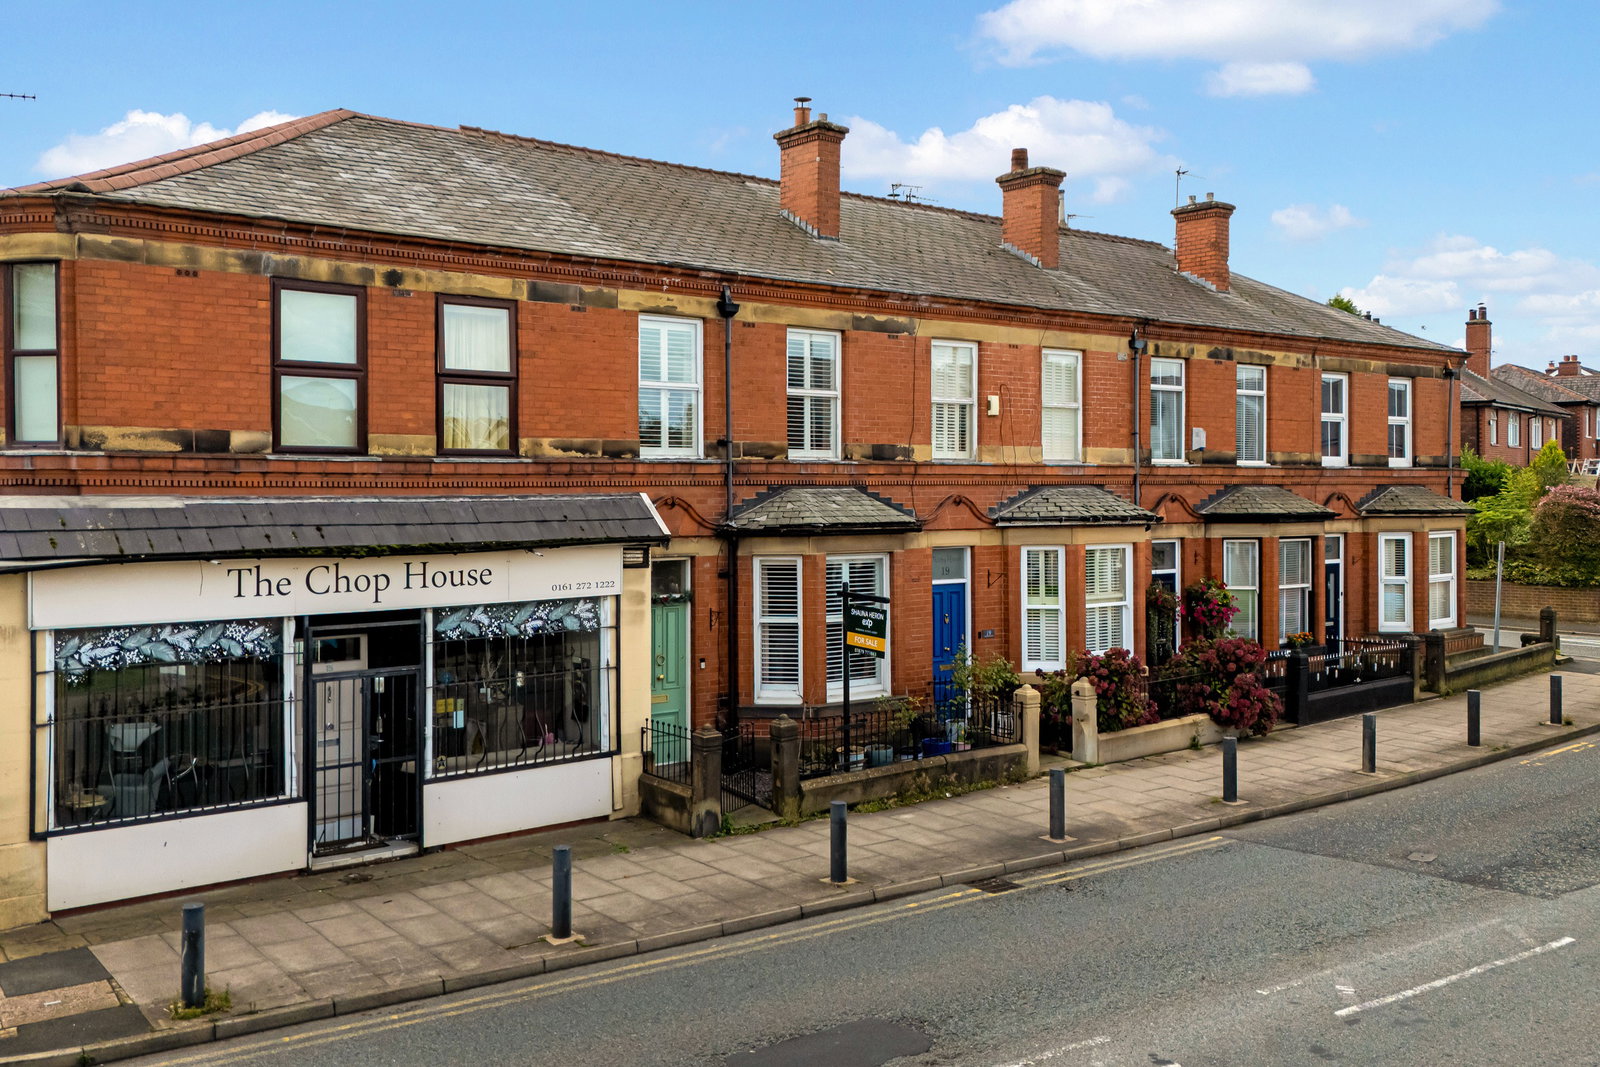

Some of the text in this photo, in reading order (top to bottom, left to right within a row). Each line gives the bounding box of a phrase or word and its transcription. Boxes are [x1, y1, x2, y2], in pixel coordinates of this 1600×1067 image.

[941, 566, 950, 576] 19
[227, 561, 493, 603] The Chop House
[551, 580, 615, 591] 0161 272 1222
[854, 636, 878, 648] FOR SALE
